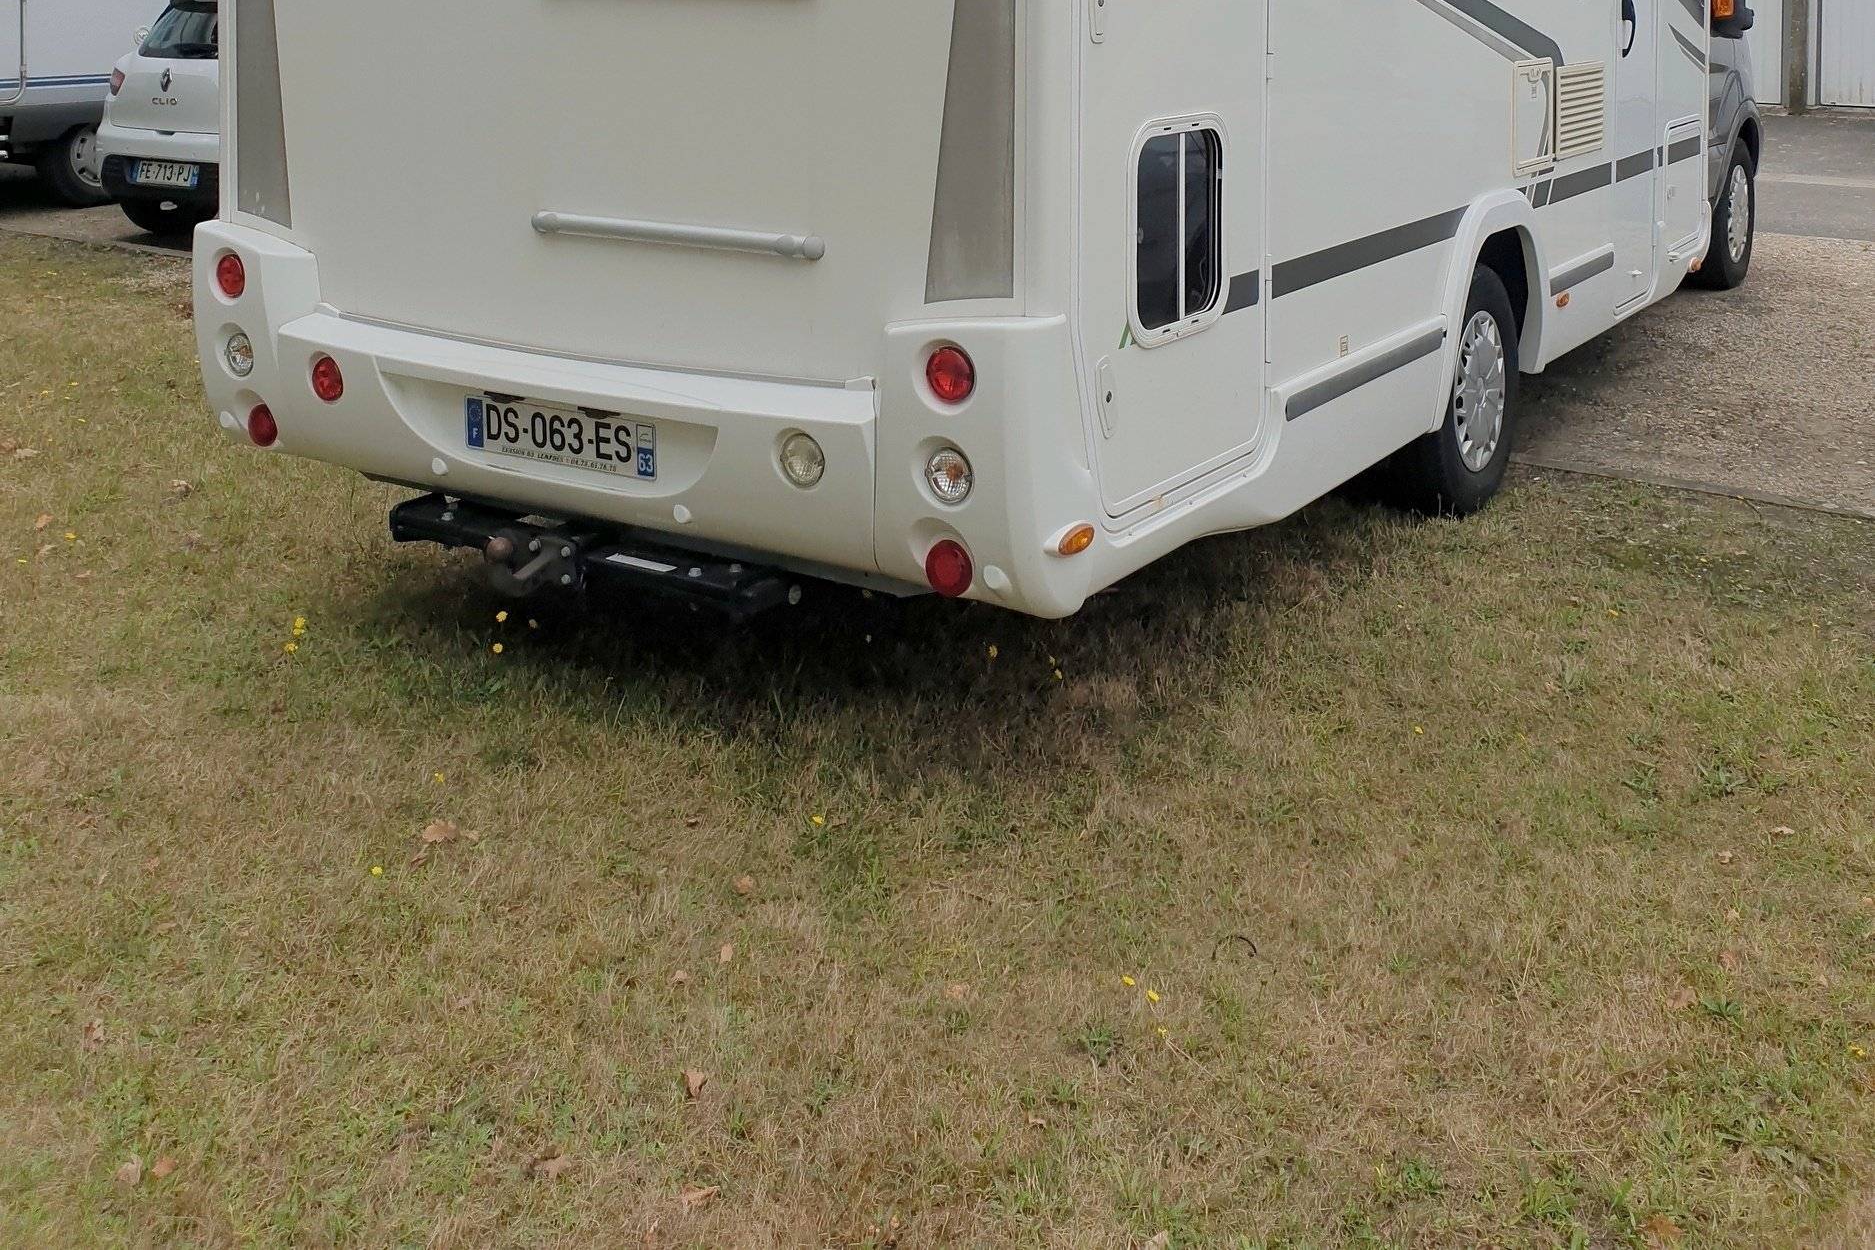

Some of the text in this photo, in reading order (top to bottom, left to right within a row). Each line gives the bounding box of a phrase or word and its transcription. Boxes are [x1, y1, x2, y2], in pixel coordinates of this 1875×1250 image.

[151, 97, 178, 106] CLIO
[485, 403, 633, 463] DS-063-ES
[638, 452, 655, 472] 63
